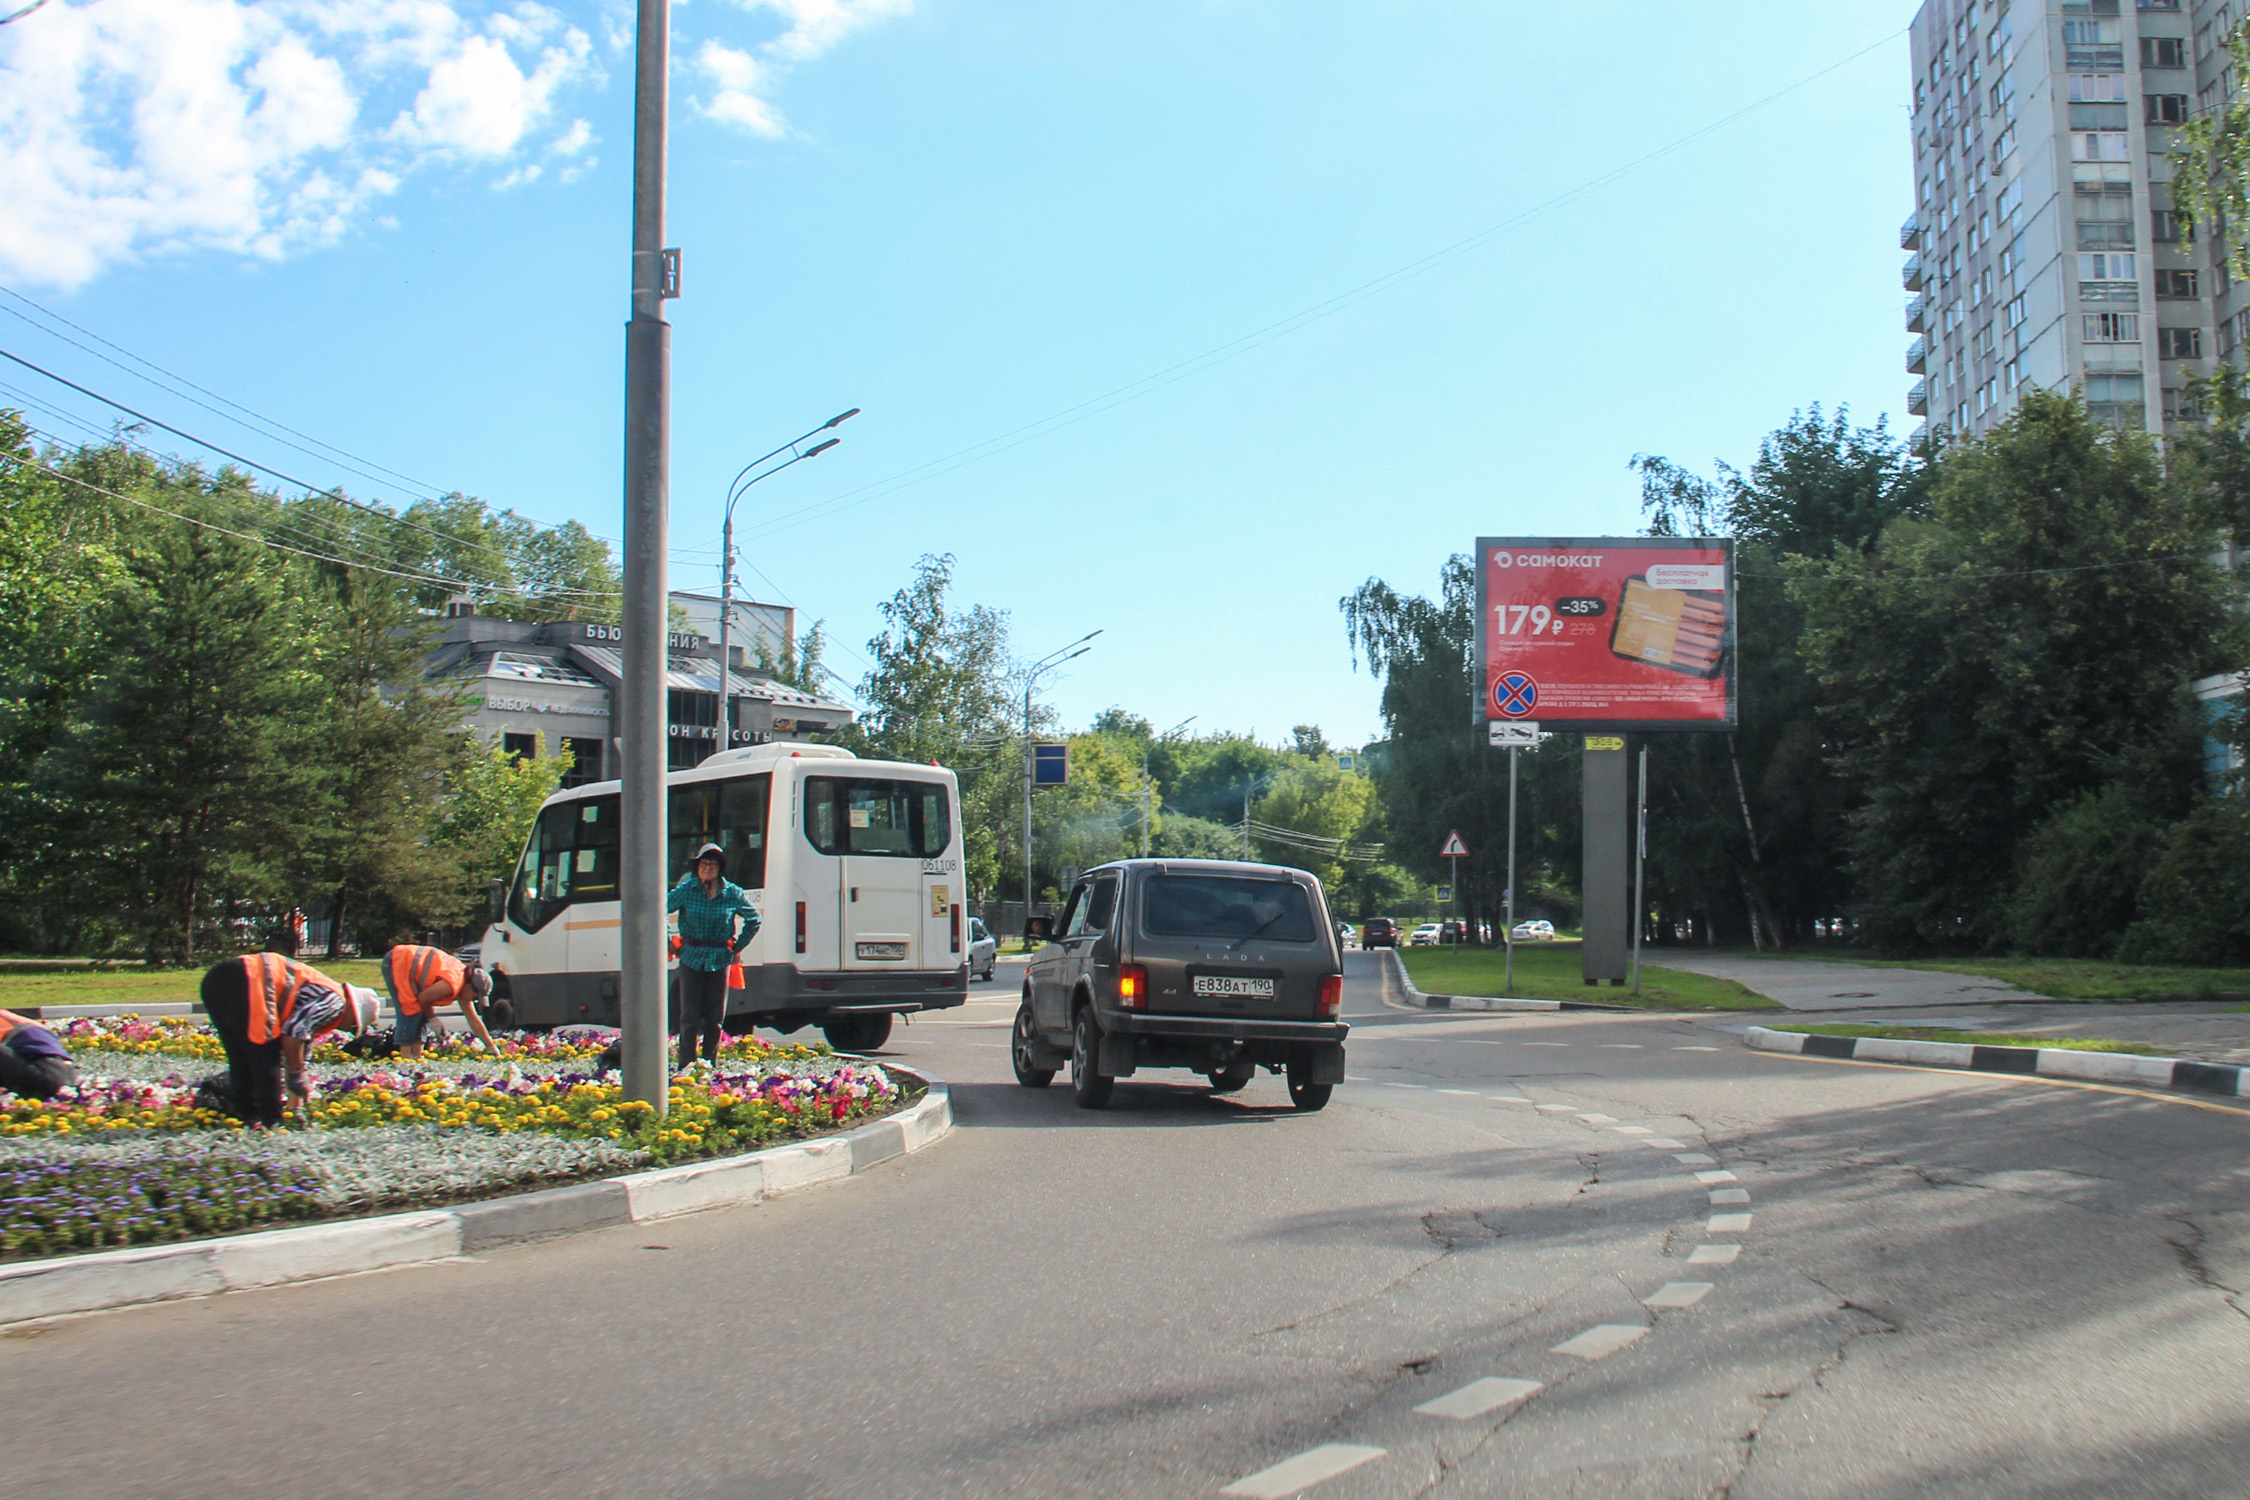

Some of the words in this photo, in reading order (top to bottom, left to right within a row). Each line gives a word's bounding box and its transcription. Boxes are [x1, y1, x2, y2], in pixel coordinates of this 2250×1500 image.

[1655, 569, 1709, 577] Бесплатная
[1655, 578, 1698, 586] доставка
[1569, 622, 1597, 636] 278
[488, 697, 530, 711] ВЫБОР
[922, 859, 957, 871] 061108
[1206, 953, 1265, 962] LADA
